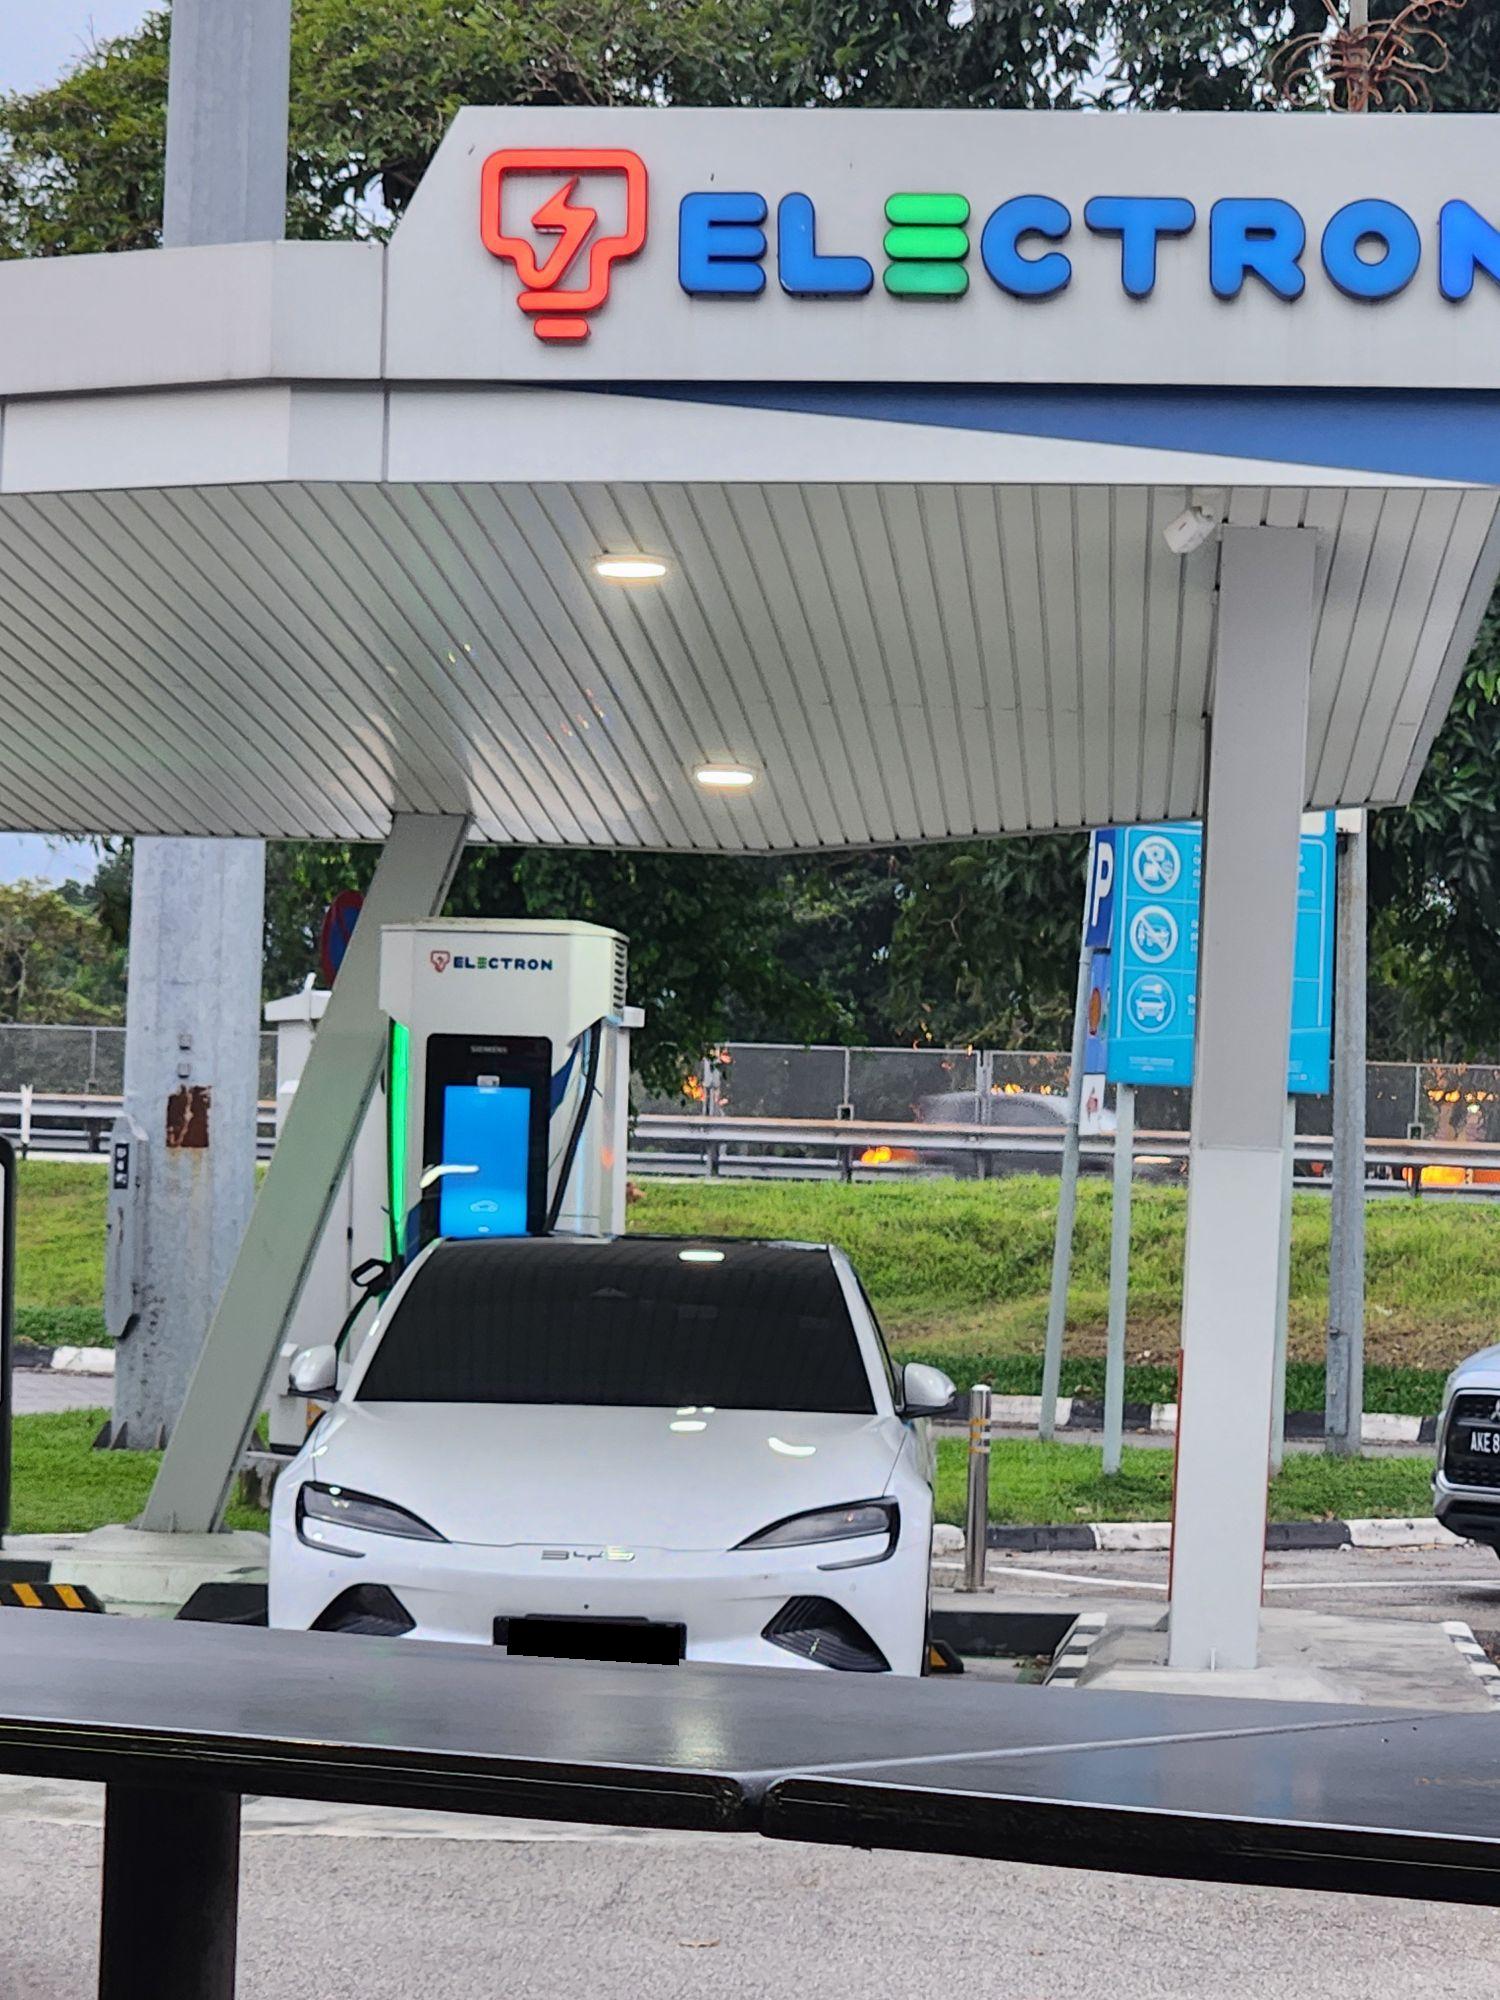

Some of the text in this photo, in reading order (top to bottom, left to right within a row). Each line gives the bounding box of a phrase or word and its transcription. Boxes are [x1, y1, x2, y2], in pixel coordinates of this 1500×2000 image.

[678, 191, 1500, 302] ELECTRON
[1093, 842, 1114, 926] P
[454, 957, 553, 970] ELECTRON
